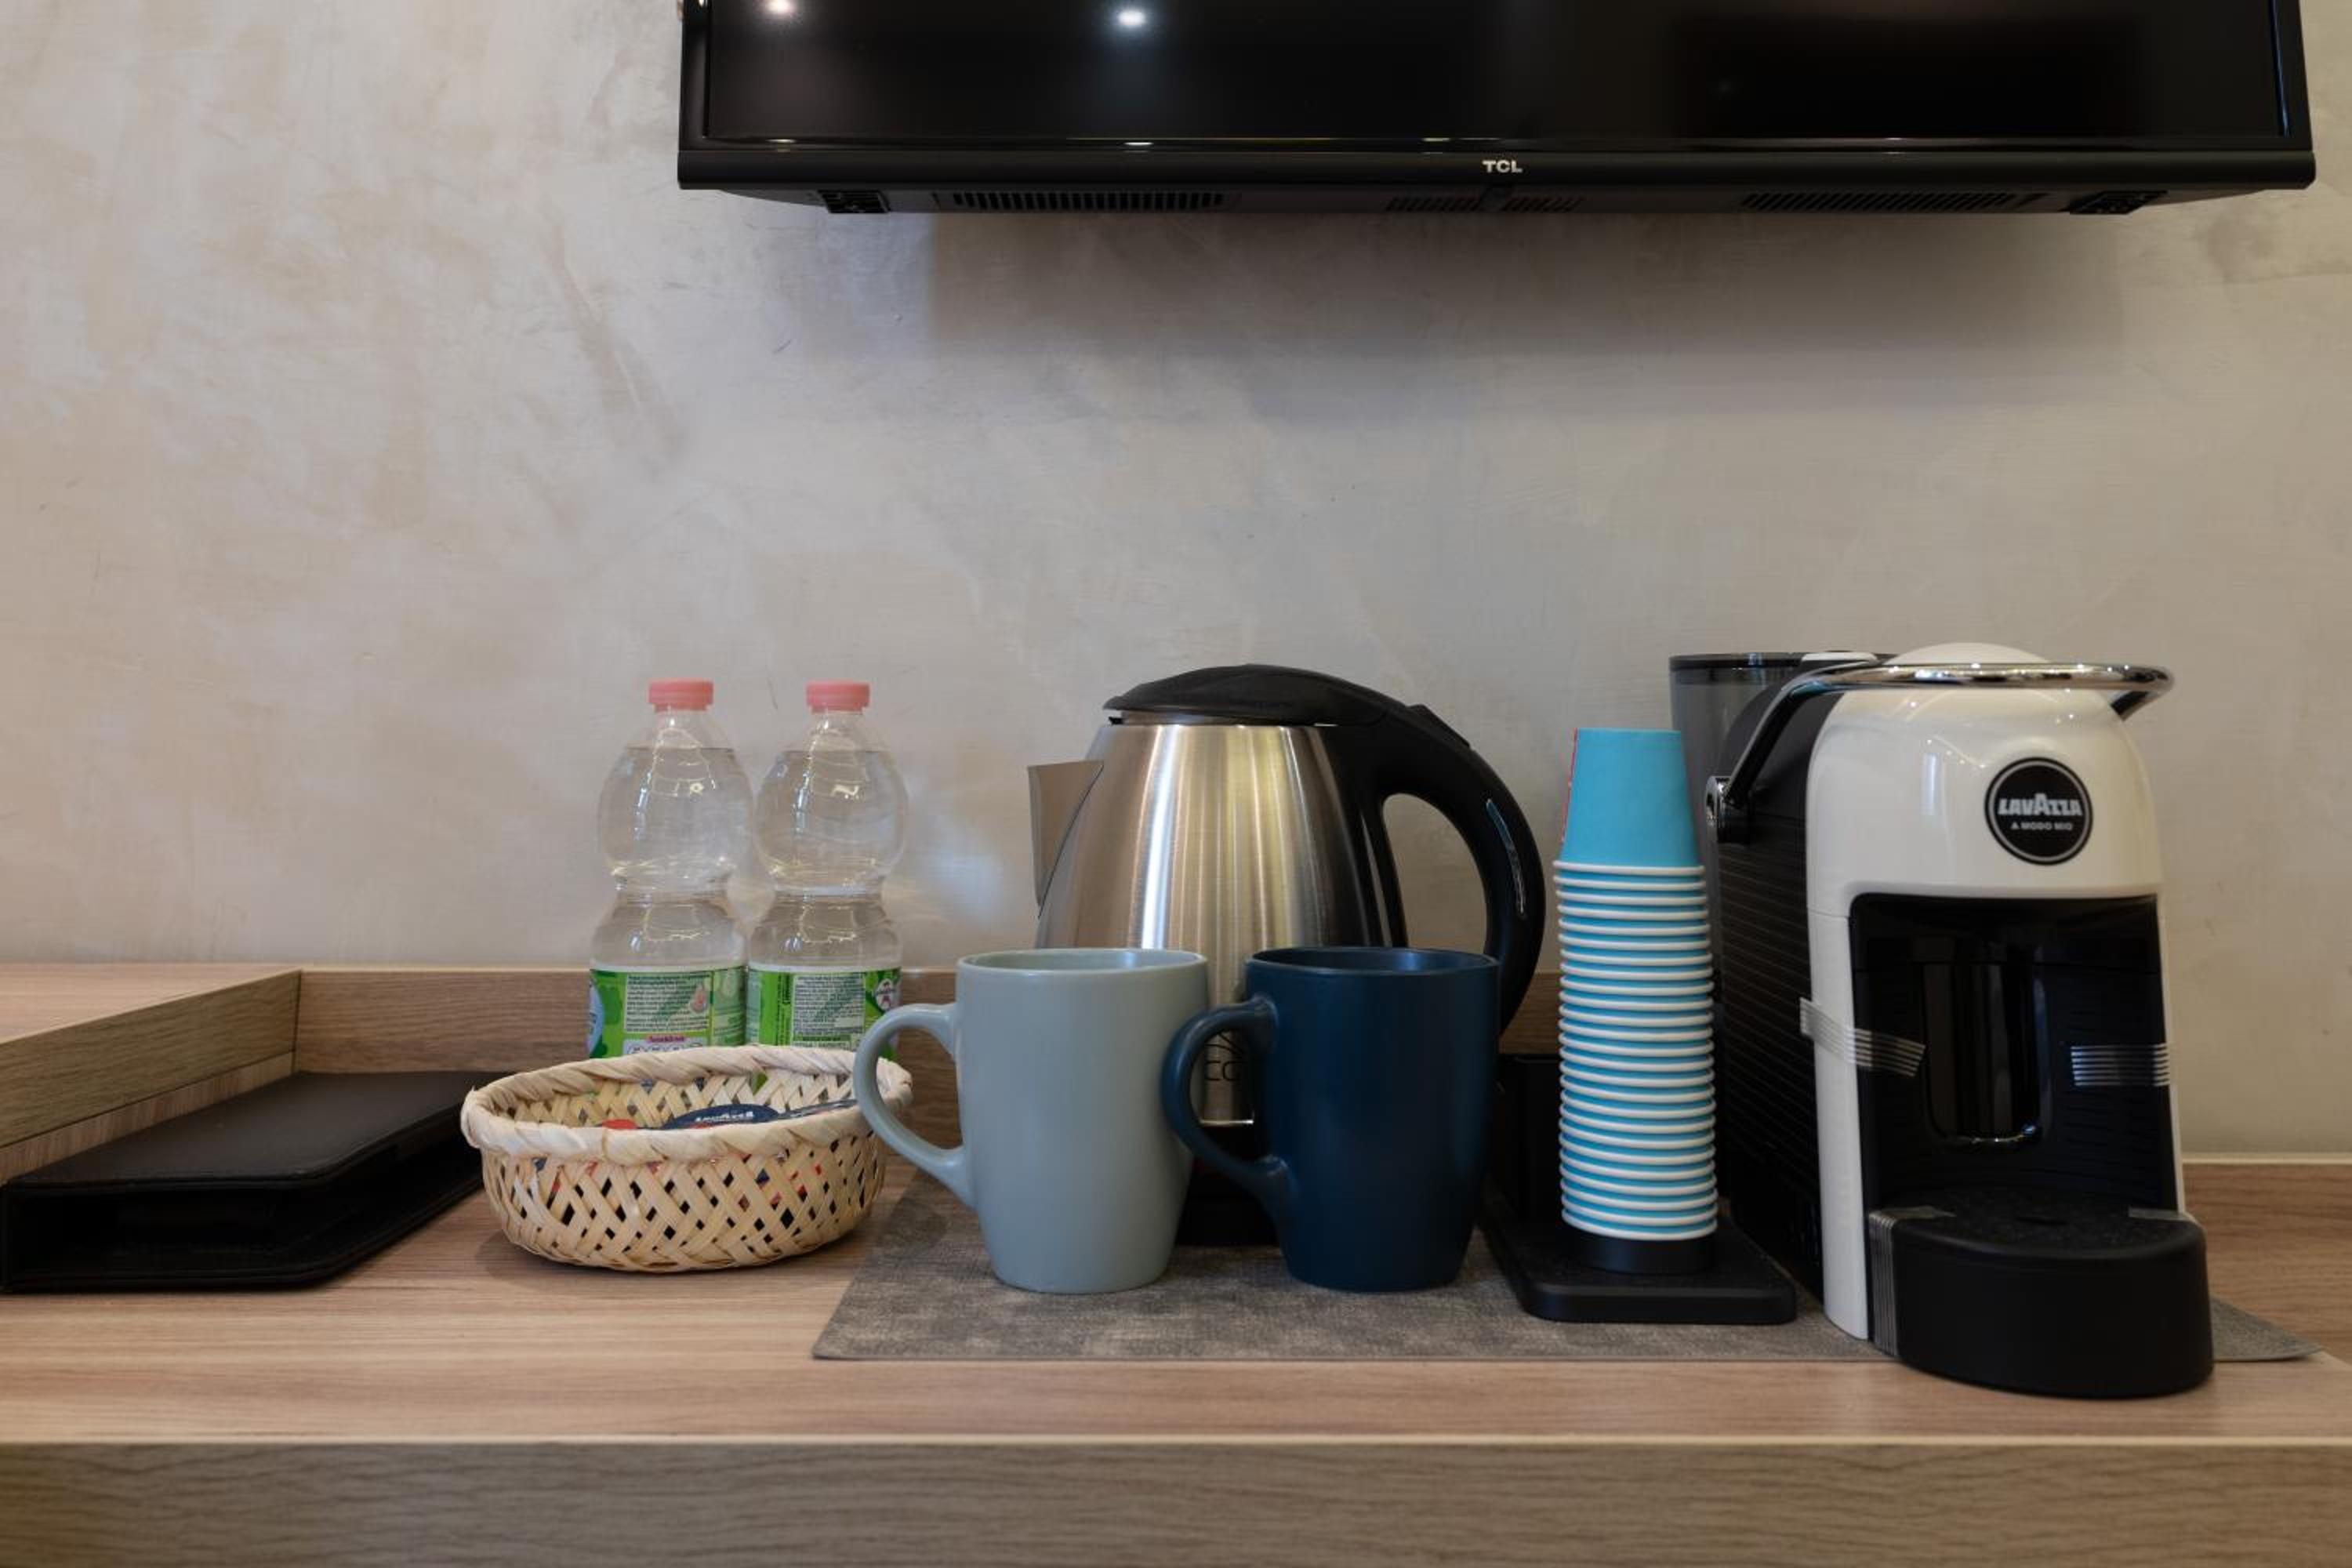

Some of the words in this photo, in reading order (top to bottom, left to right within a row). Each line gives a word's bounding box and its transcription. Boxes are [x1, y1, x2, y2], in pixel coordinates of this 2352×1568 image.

[1482, 159, 1523, 172] TCL
[1998, 793, 2082, 816] LAVAZZA
[2010, 822, 2020, 830] A
[2020, 822, 2053, 831] MODO
